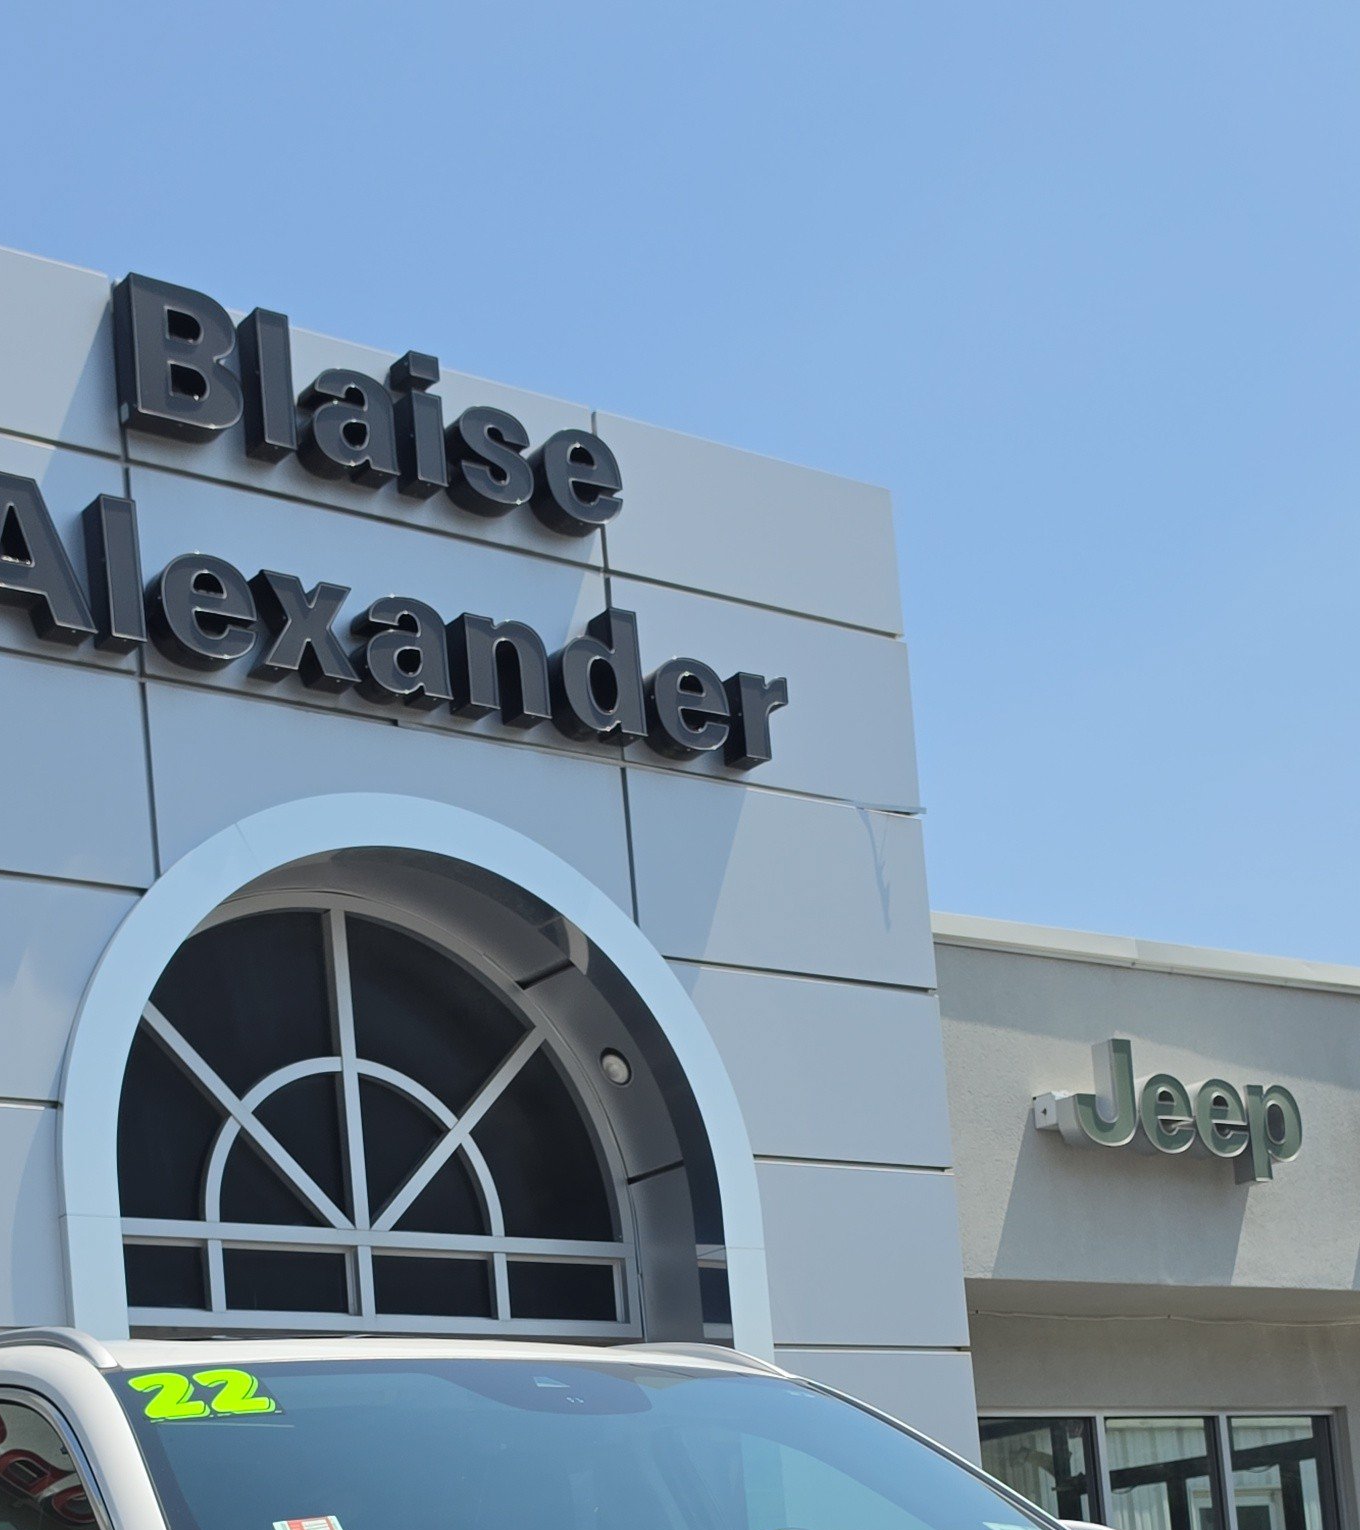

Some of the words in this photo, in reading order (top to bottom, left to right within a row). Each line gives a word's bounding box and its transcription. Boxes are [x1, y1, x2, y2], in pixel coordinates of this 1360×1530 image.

[112, 271, 624, 536] Blaise
[1056, 1038, 1302, 1184] Jeep
[128, 1369, 276, 1420] 22
